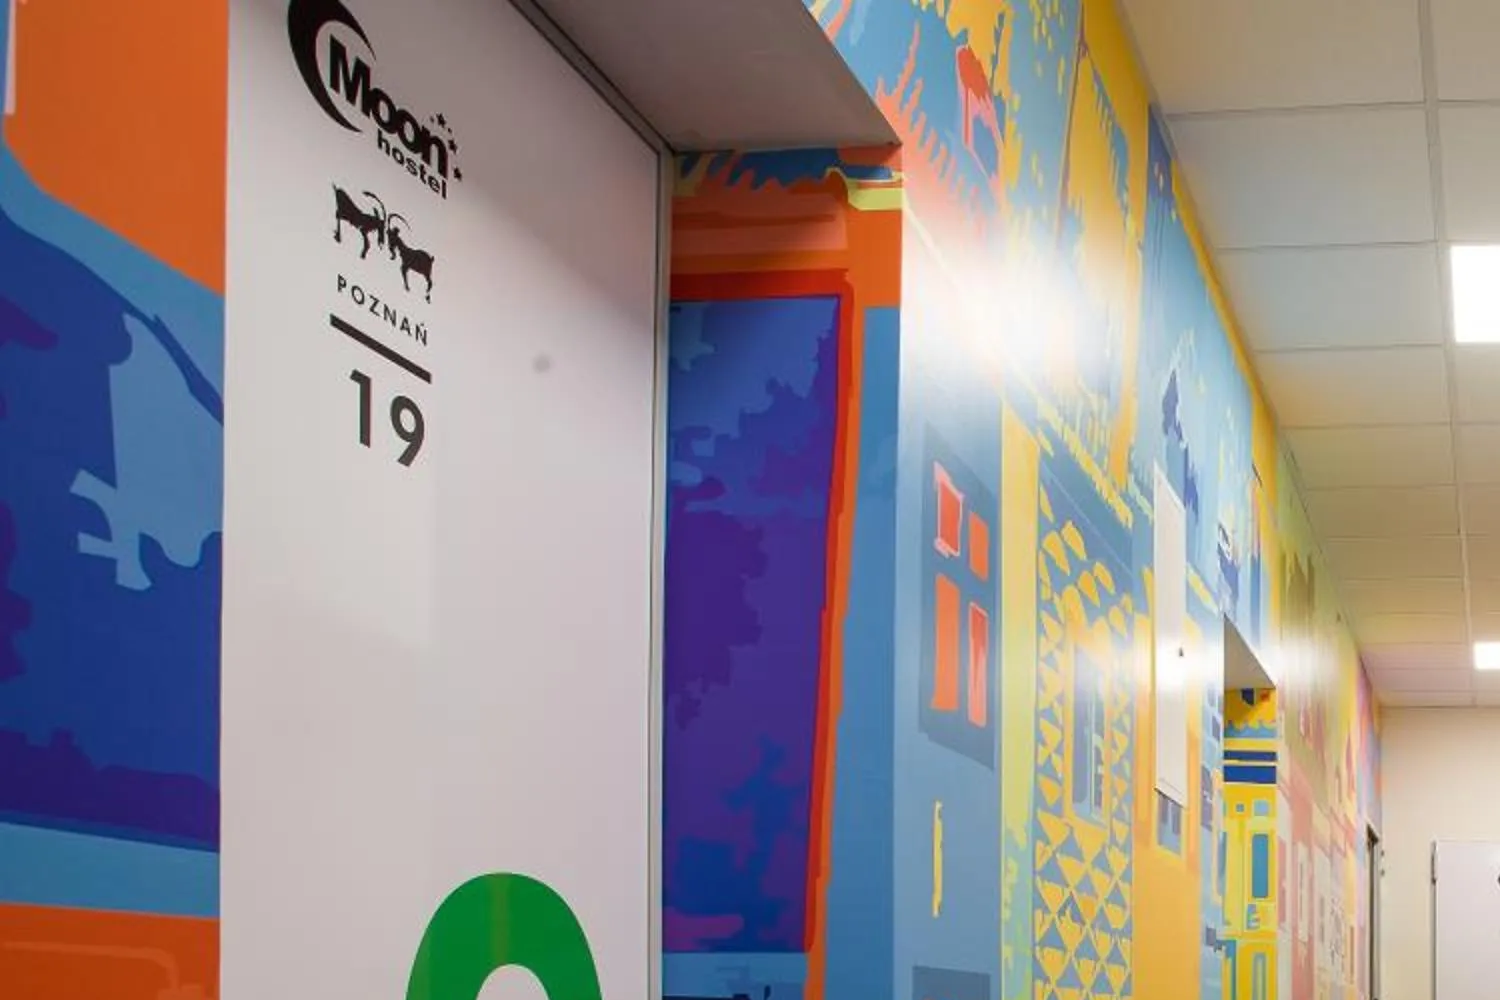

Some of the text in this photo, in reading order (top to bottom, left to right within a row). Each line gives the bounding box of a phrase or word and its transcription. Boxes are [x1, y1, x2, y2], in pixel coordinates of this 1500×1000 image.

[329, 34, 449, 180] Moon
[377, 128, 448, 199] hostel
[336, 273, 428, 347] POZNAŃ
[350, 369, 425, 467] 19
